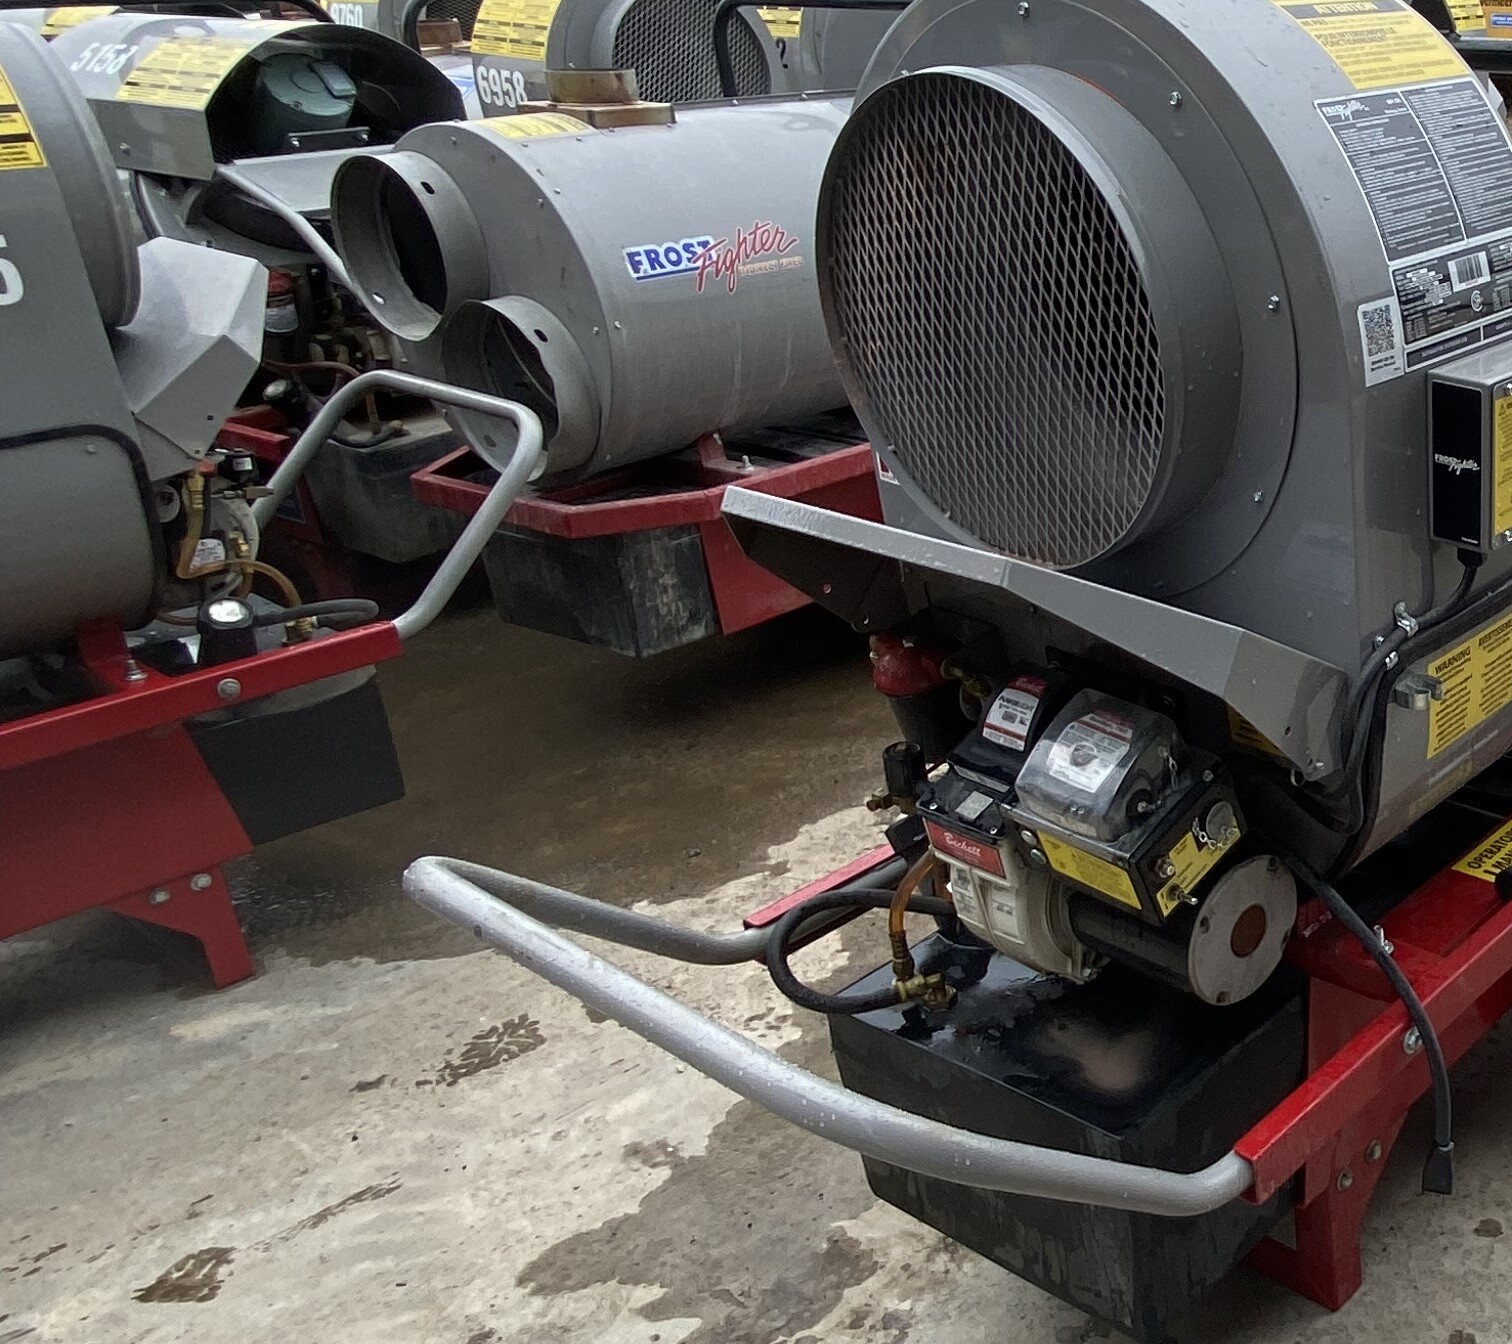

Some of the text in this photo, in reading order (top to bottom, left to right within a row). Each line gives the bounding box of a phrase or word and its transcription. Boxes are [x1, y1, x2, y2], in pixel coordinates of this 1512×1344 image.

[1312, 1, 1379, 15] ATTENTION
[475, 65, 529, 108] 6958
[626, 221, 798, 293] FROST Fighter
[1434, 645, 1471, 675] WARNING
[943, 832, 981, 857] Beckett
